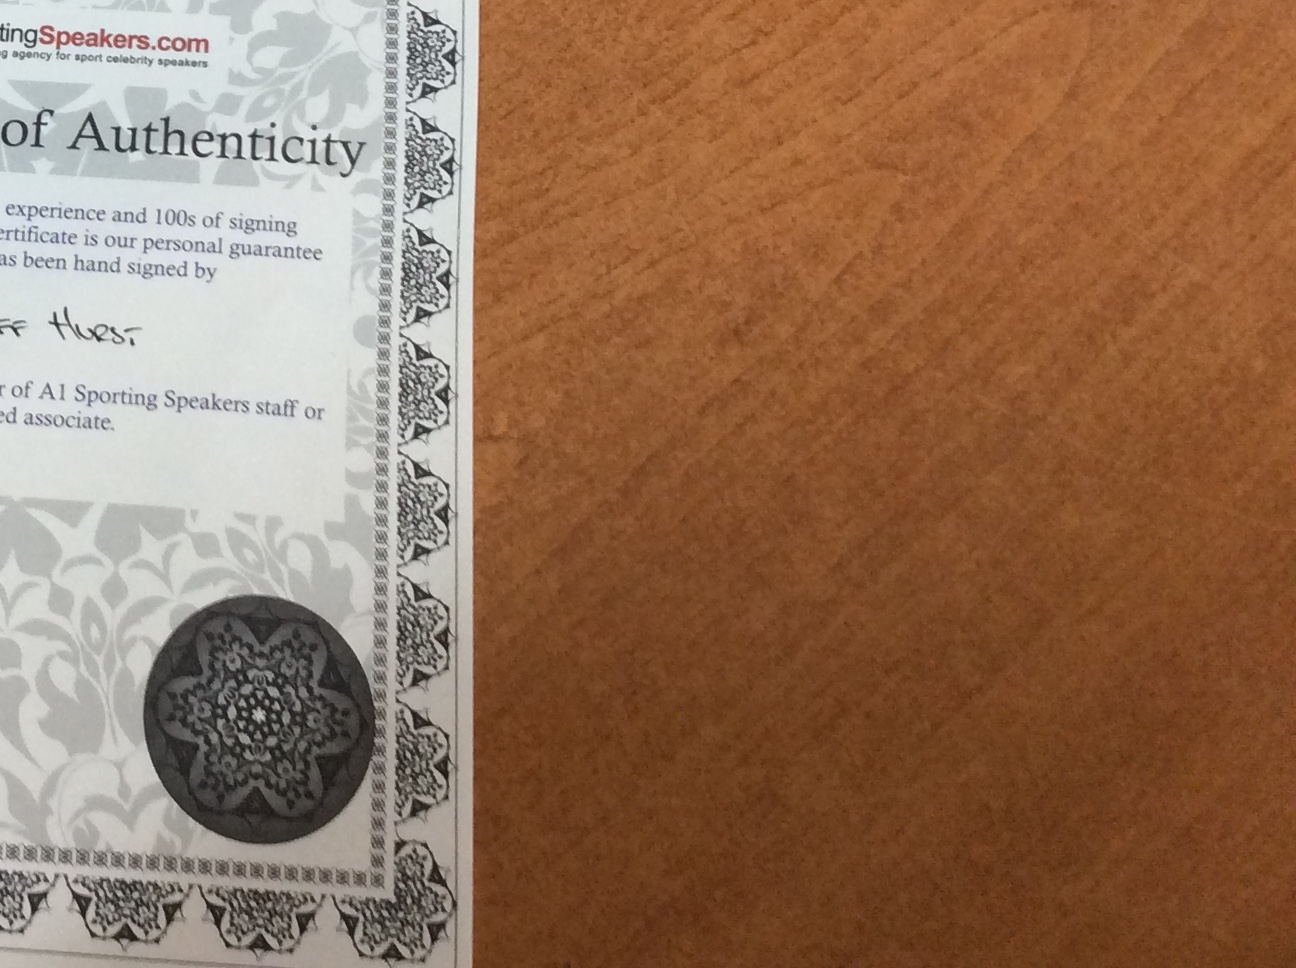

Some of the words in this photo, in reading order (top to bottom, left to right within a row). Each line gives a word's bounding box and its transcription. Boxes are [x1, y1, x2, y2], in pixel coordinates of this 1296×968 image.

[11, 49, 52, 62] agency
[55, 50, 72, 61] for
[74, 51, 103, 64] sport
[106, 53, 154, 68] celebrity
[157, 56, 209, 69] speakers
[0, 108, 55, 148] of
[66, 111, 367, 178] Authenticity
[5, 202, 107, 222] experience
[111, 207, 147, 225] and
[155, 208, 197, 228] 100s
[201, 210, 225, 230] of
[228, 213, 298, 237] signing
[83, 228, 99, 248] is
[104, 233, 137, 250] our
[142, 236, 223, 255] personal
[228, 240, 324, 262] guarantee
[23, 249, 68, 271] been
[74, 254, 122, 274] hand
[126, 257, 188, 280] signed
[194, 260, 218, 283] by
[10, 380, 34, 399] of
[38, 382, 66, 401] A1
[74, 383, 158, 411] Sporting
[163, 389, 251, 414] Speakers
[255, 398, 300, 418] staff
[304, 405, 326, 421] or
[23, 409, 116, 432] associate.
